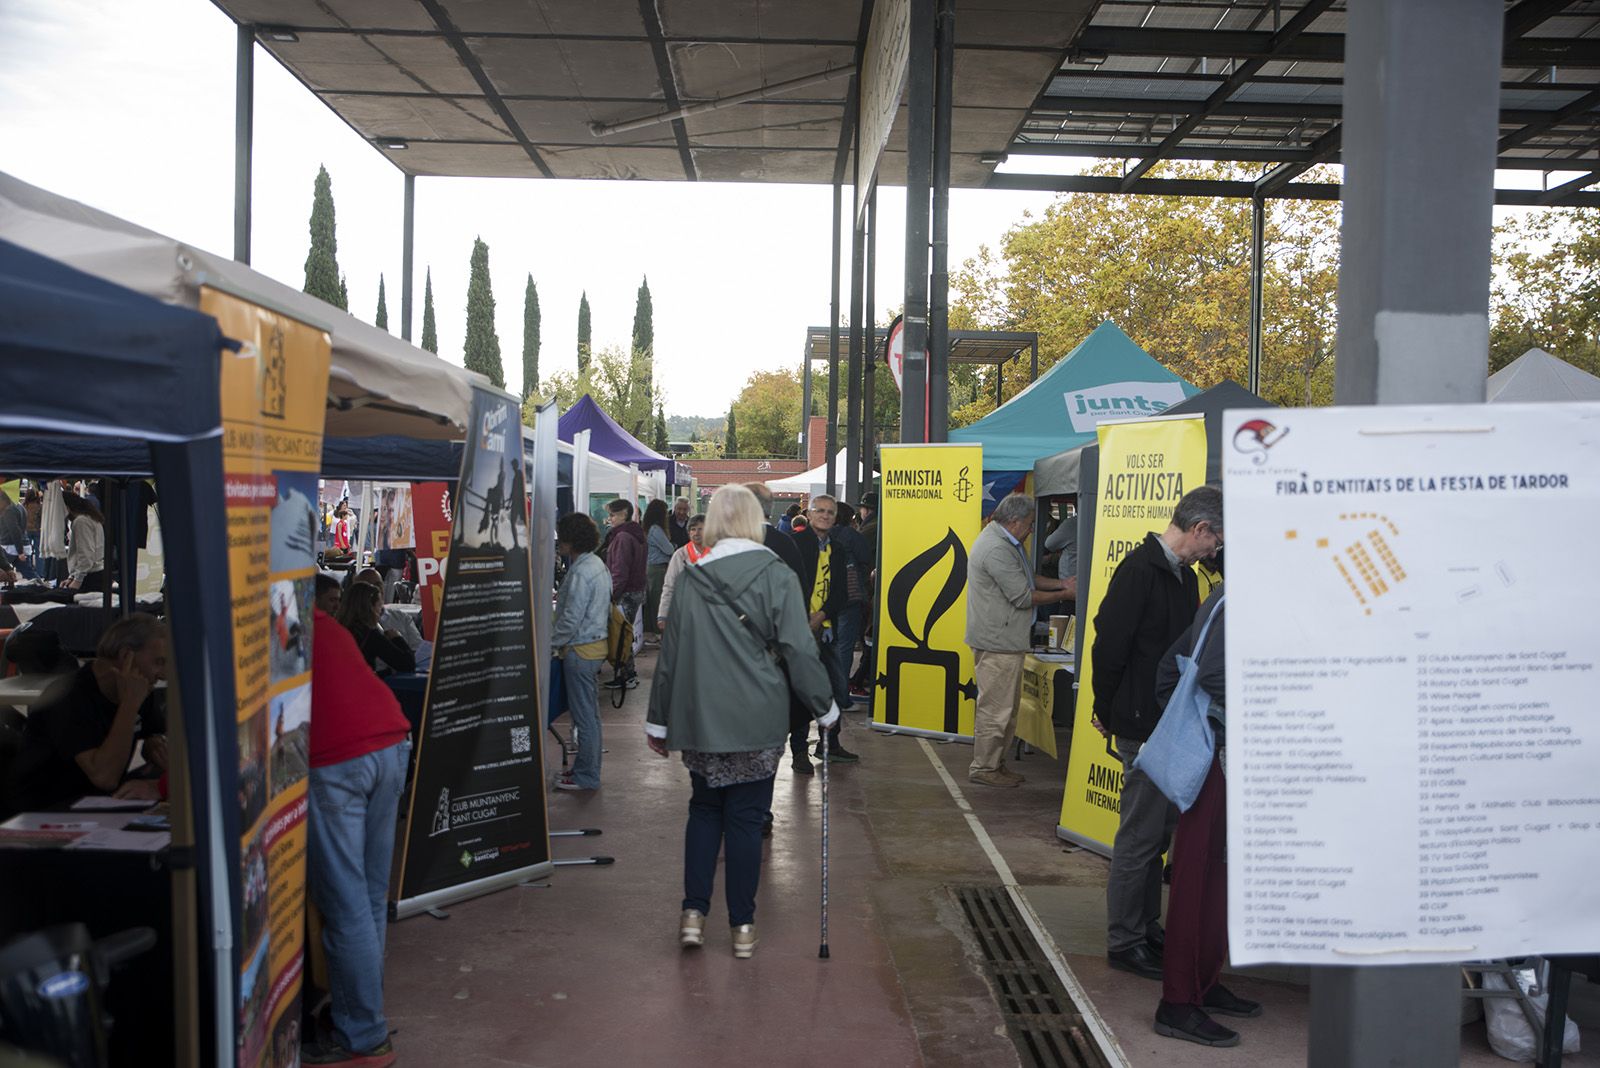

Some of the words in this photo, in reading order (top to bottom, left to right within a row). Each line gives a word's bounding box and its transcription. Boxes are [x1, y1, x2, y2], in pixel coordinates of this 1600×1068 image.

[1075, 394, 1169, 415] junts
[1127, 455, 1146, 469] VOLS
[1148, 454, 1164, 468] SER
[886, 470, 943, 486] AMNISTIA
[1105, 473, 1183, 501] ACTIVISTA
[1313, 479, 1391, 494] D'ENTITATS
[1396, 478, 1414, 492] DE
[1419, 478, 1436, 491] LA
[1441, 477, 1484, 490] FESTA
[1489, 476, 1506, 490] DE
[1512, 474, 1569, 489] TARDOR
[886, 488, 943, 500] INTERNACIONAL
[1103, 505, 1121, 518] PELS
[1146, 506, 1176, 520] HUMAN
[1088, 763, 1124, 795] AMNIS
[452, 801, 469, 813] CLUB
[470, 791, 520, 808] MUNTANYENC
[452, 811, 471, 824] SANT
[472, 807, 497, 821] CUGAT
